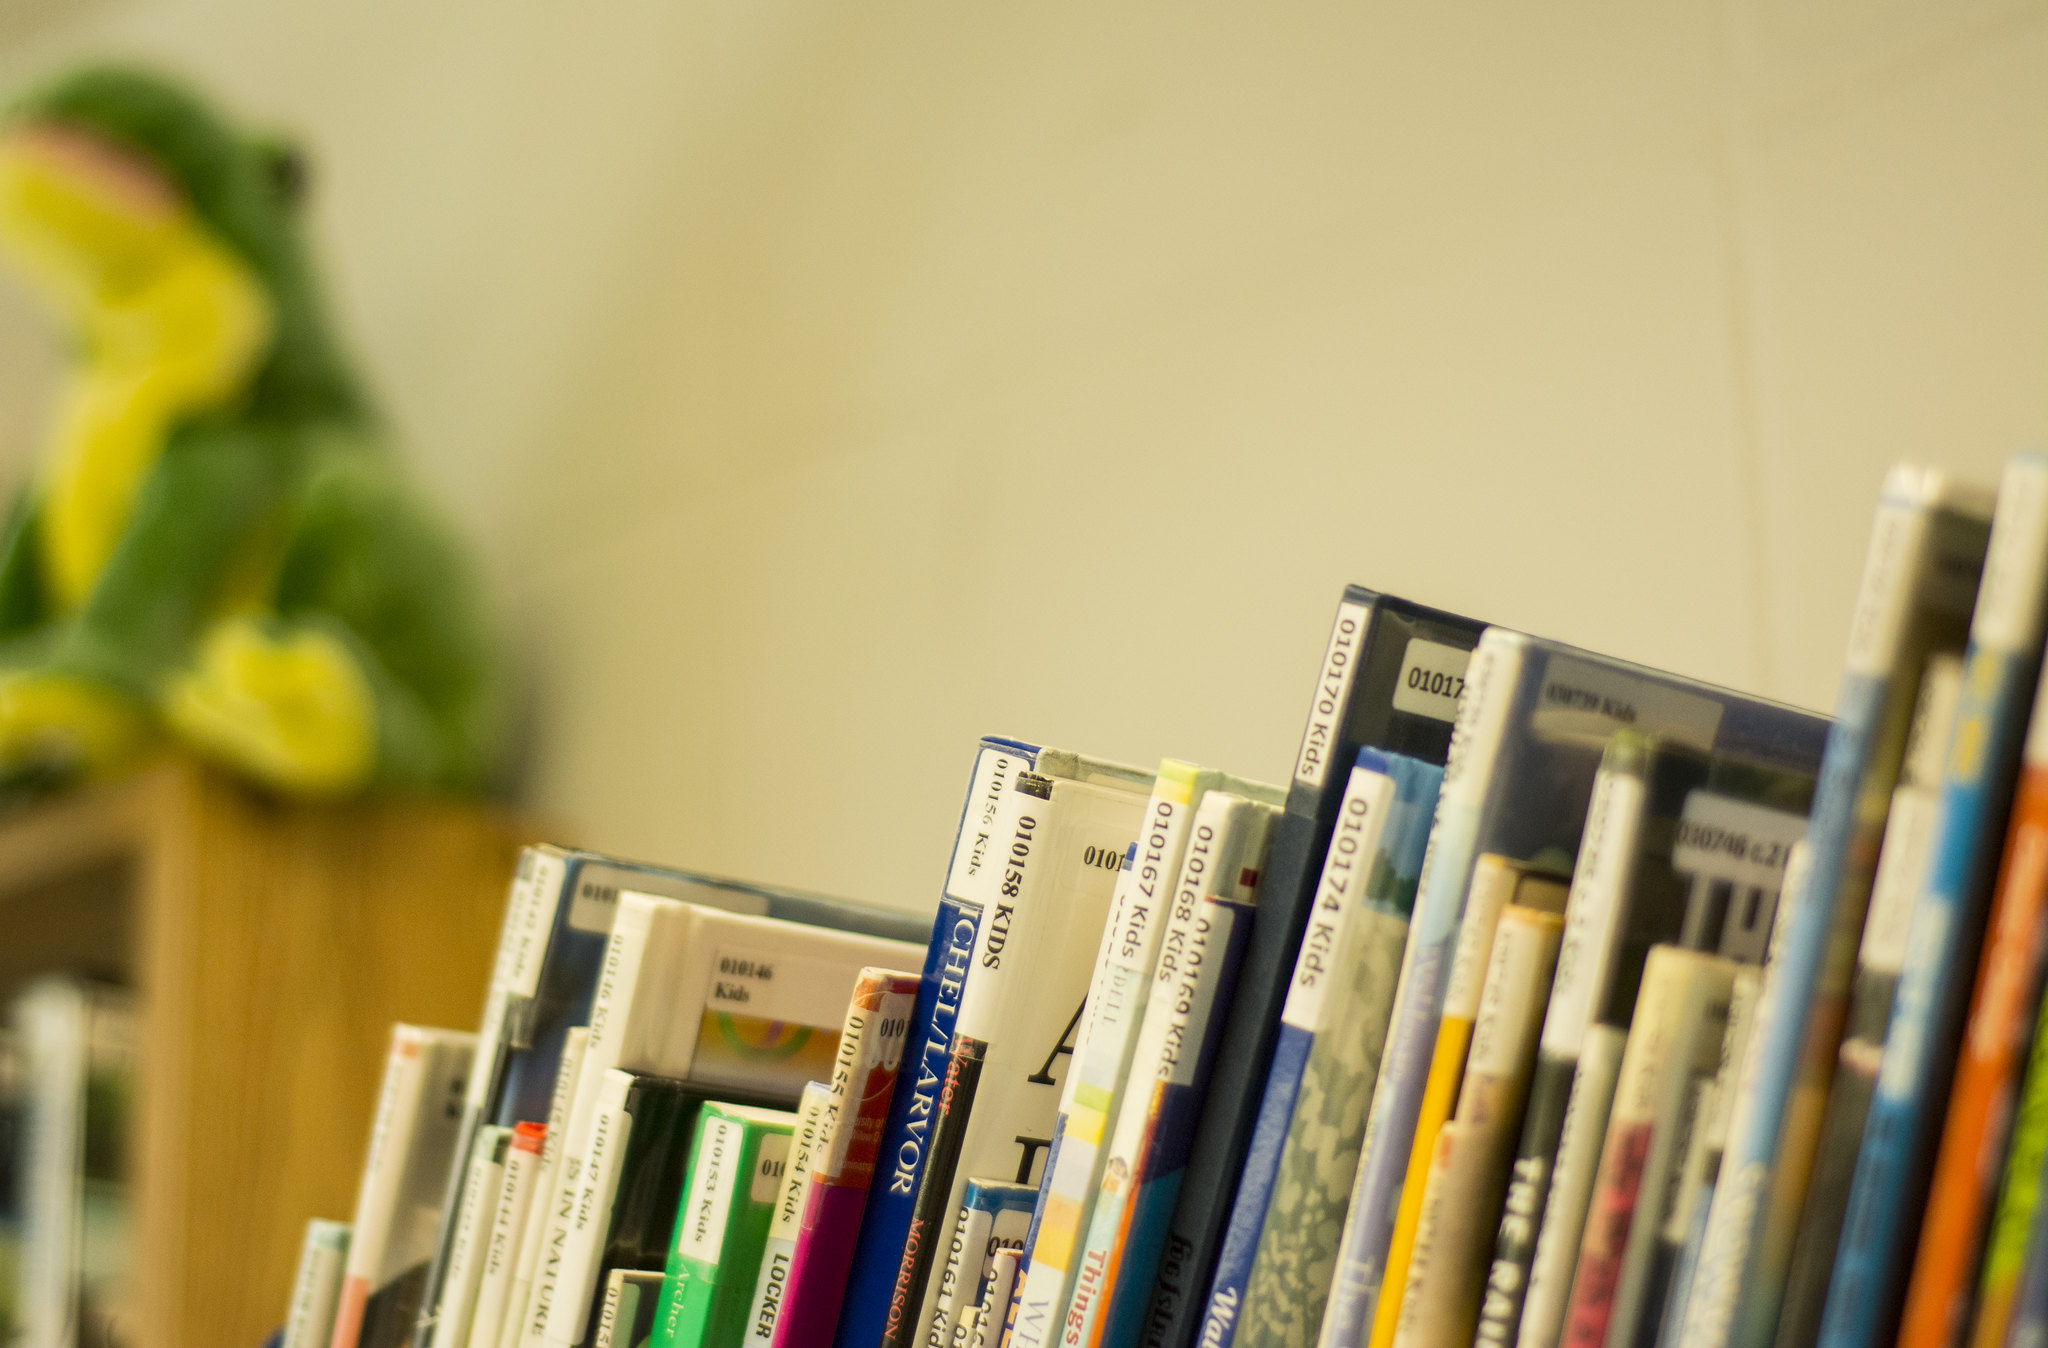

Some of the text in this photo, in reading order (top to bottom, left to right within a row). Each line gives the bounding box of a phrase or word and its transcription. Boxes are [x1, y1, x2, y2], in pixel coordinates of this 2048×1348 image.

[1300, 618, 1357, 777] 010170 Kids
[967, 758, 1009, 876] 010156 Kids
[981, 815, 1037, 970] 010158 KIDS
[1121, 801, 1173, 959] 010167 Kids
[1159, 825, 1214, 983] 010168 Kids
[1299, 797, 1368, 988] 010174 Kids
[588, 934, 624, 1049] 010146 Kids
[714, 956, 774, 1002] 010146 Kids
[880, 1018, 909, 1038] 010
[1157, 917, 1211, 1080] 010169 Kids
[815, 1014, 865, 1154] 010155 Kids
[559, 1187, 577, 1219] IN
[575, 1113, 612, 1231] 010147 Kids
[694, 1123, 729, 1244] 010153 Kids
[781, 1105, 821, 1224] 010154 Kids
[665, 1263, 692, 1340] Archer
[755, 1252, 790, 1340] LOCKER
[883, 1218, 926, 1341] MORRISON
[940, 1205, 970, 1299] 010161
[1065, 1249, 1107, 1346] Things
